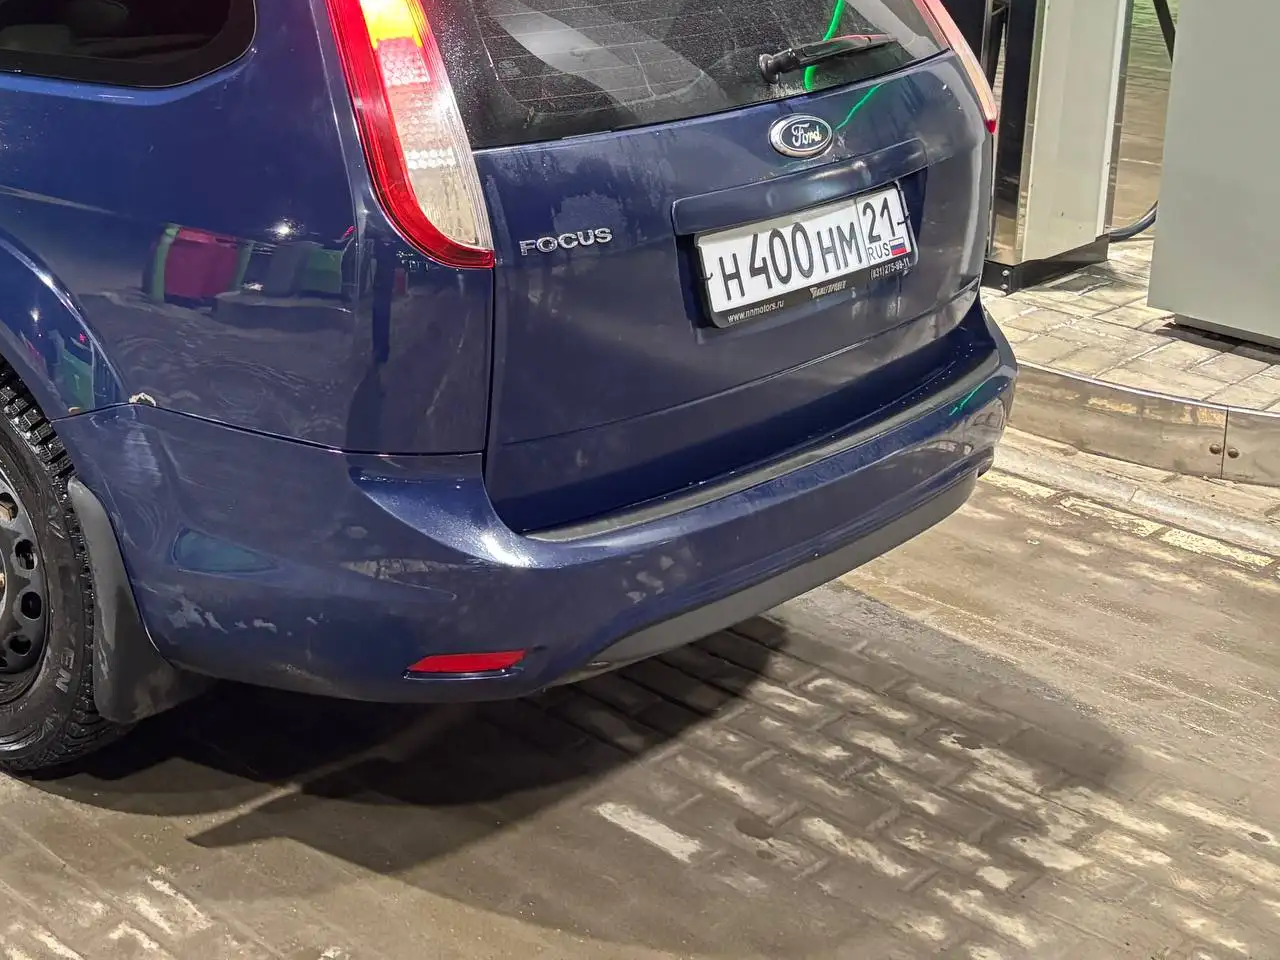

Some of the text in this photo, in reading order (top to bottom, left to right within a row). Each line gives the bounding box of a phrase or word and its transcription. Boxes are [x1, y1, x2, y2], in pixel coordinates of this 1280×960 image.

[791, 122, 823, 147] Ford
[862, 196, 896, 245] 21
[519, 227, 613, 256] FOCUS
[867, 242, 891, 262] RUS
